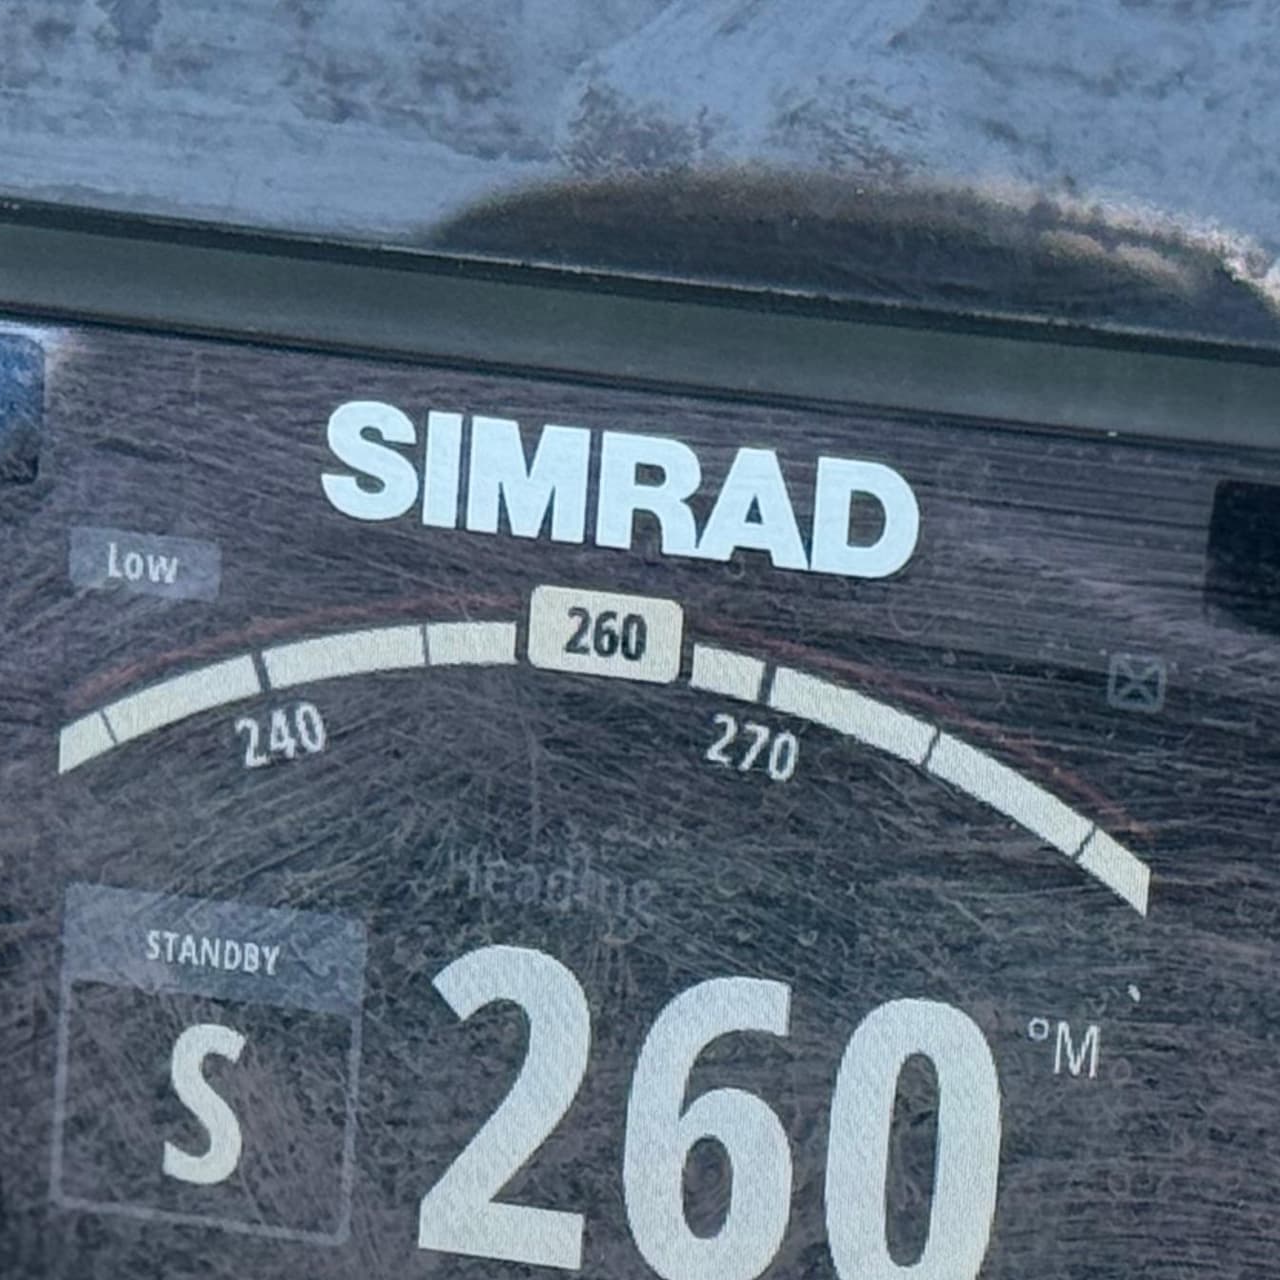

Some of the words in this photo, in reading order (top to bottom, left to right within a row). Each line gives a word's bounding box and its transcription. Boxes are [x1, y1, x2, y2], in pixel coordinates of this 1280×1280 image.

[321, 400, 920, 580] SIMRAD
[107, 542, 179, 584] Low
[565, 606, 648, 662] 260
[235, 702, 327, 767] 240
[705, 713, 800, 782] 270
[145, 930, 281, 976] STANDBY
[162, 1023, 247, 1185] S
